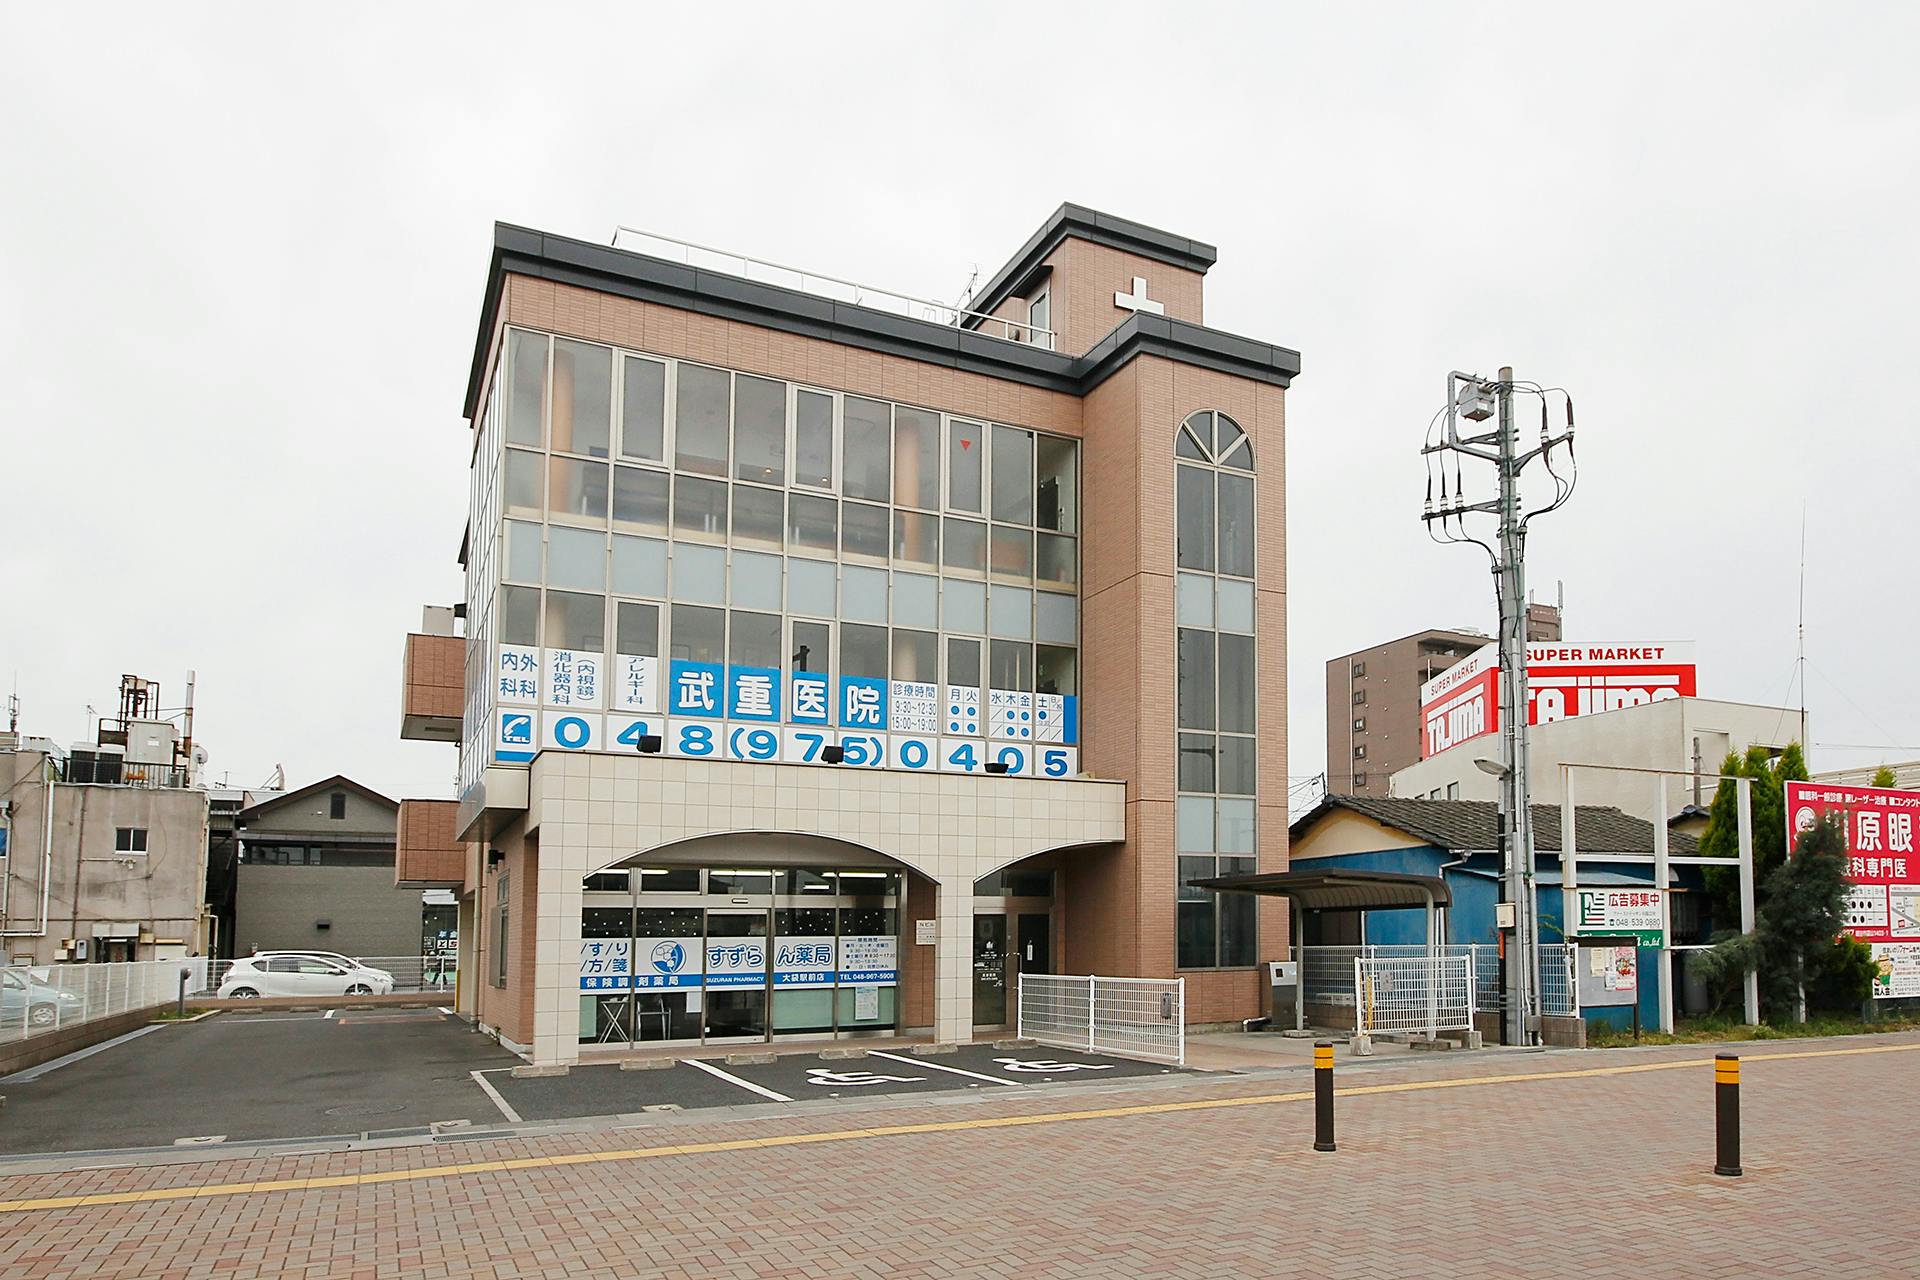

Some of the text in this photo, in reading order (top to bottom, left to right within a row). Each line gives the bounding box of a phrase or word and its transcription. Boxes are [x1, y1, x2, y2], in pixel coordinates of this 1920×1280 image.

[1523, 648, 1665, 661] SUPER MARKET
[500, 652, 518, 697] 内科
[519, 654, 538, 699] 外科
[552, 651, 572, 705] 消化器内科
[1430, 658, 1479, 697] SUPER MARKET
[677, 669, 880, 725] 武重医院
[893, 683, 936, 699] 診療時間
[950, 688, 977, 701] 月 火
[991, 692, 1031, 707] 水 木 金
[502, 735, 530, 743] TEL
[708, 944, 833, 968] すずらん薬局
